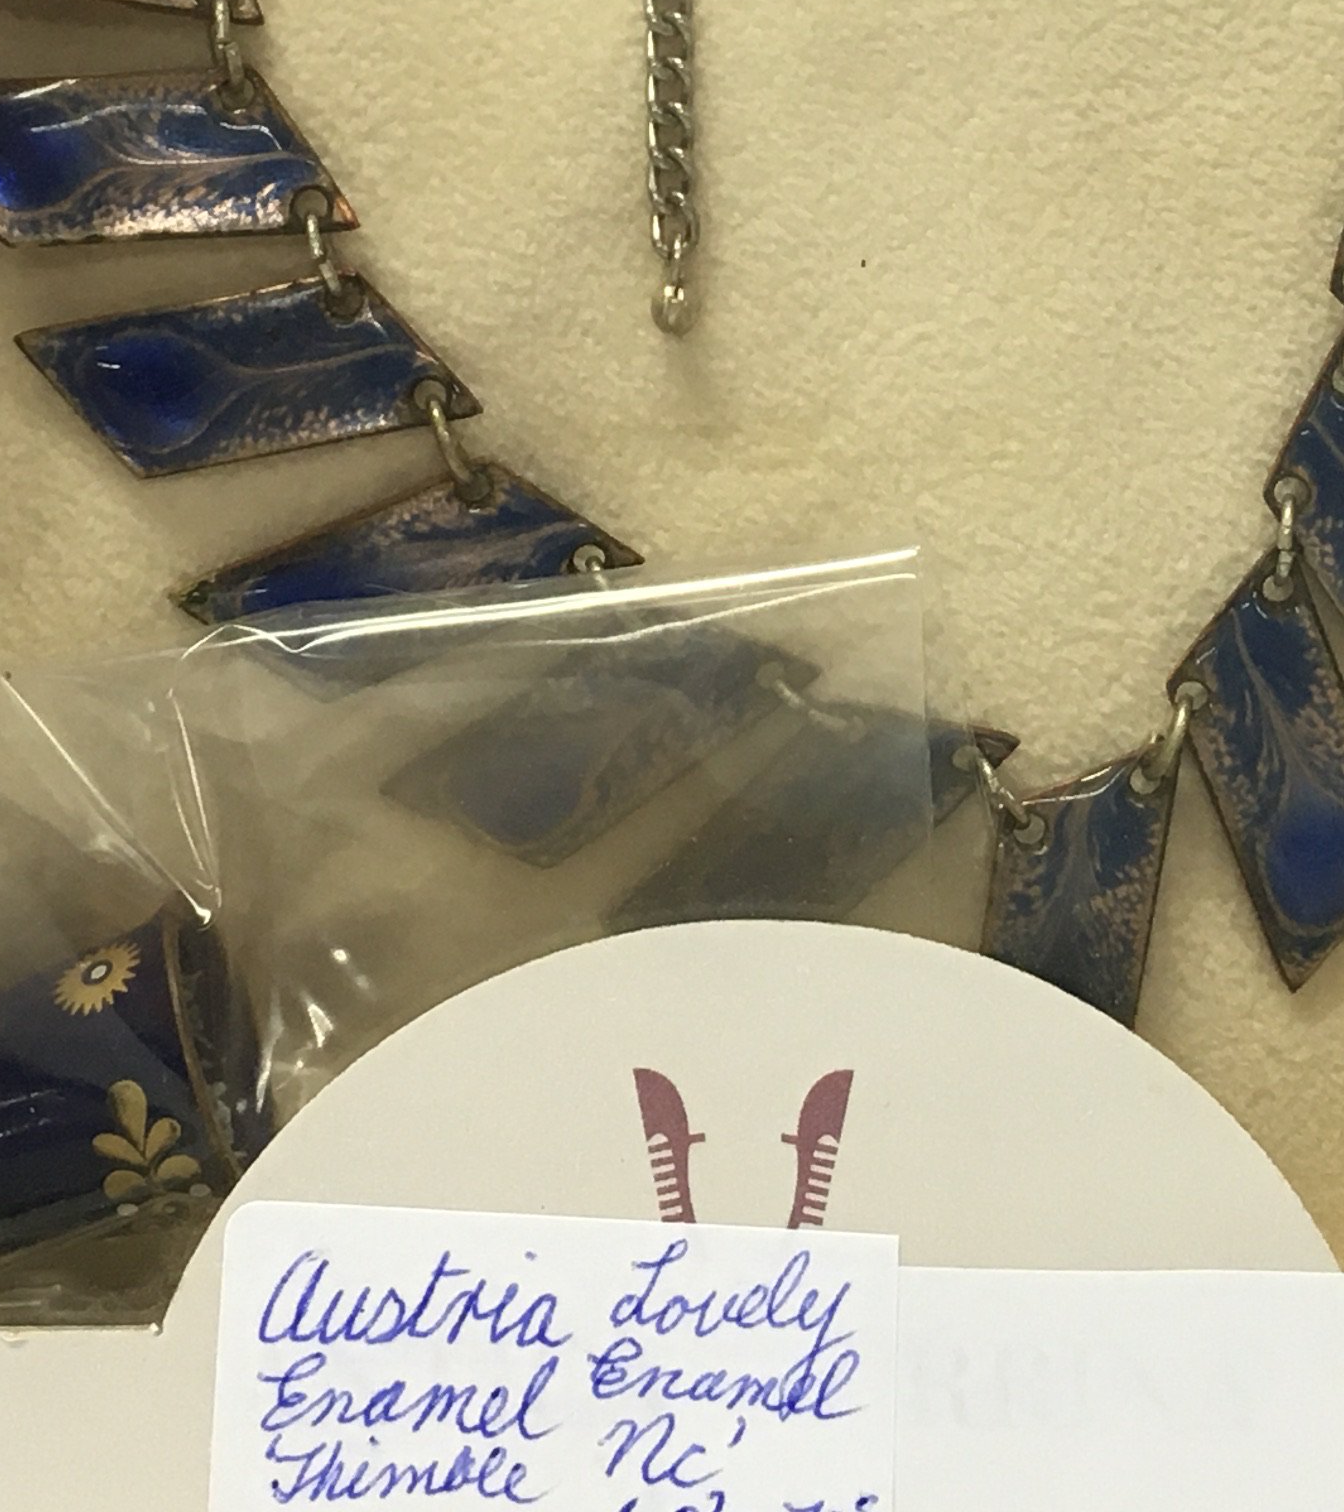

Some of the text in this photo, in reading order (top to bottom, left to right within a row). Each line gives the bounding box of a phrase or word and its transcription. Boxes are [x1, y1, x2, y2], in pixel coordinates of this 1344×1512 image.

[256, 1351, 566, 1440] Enamel
[587, 1336, 870, 1421] Enamel
[258, 1249, 574, 1348] Austria
[609, 1237, 859, 1423] Lovely
